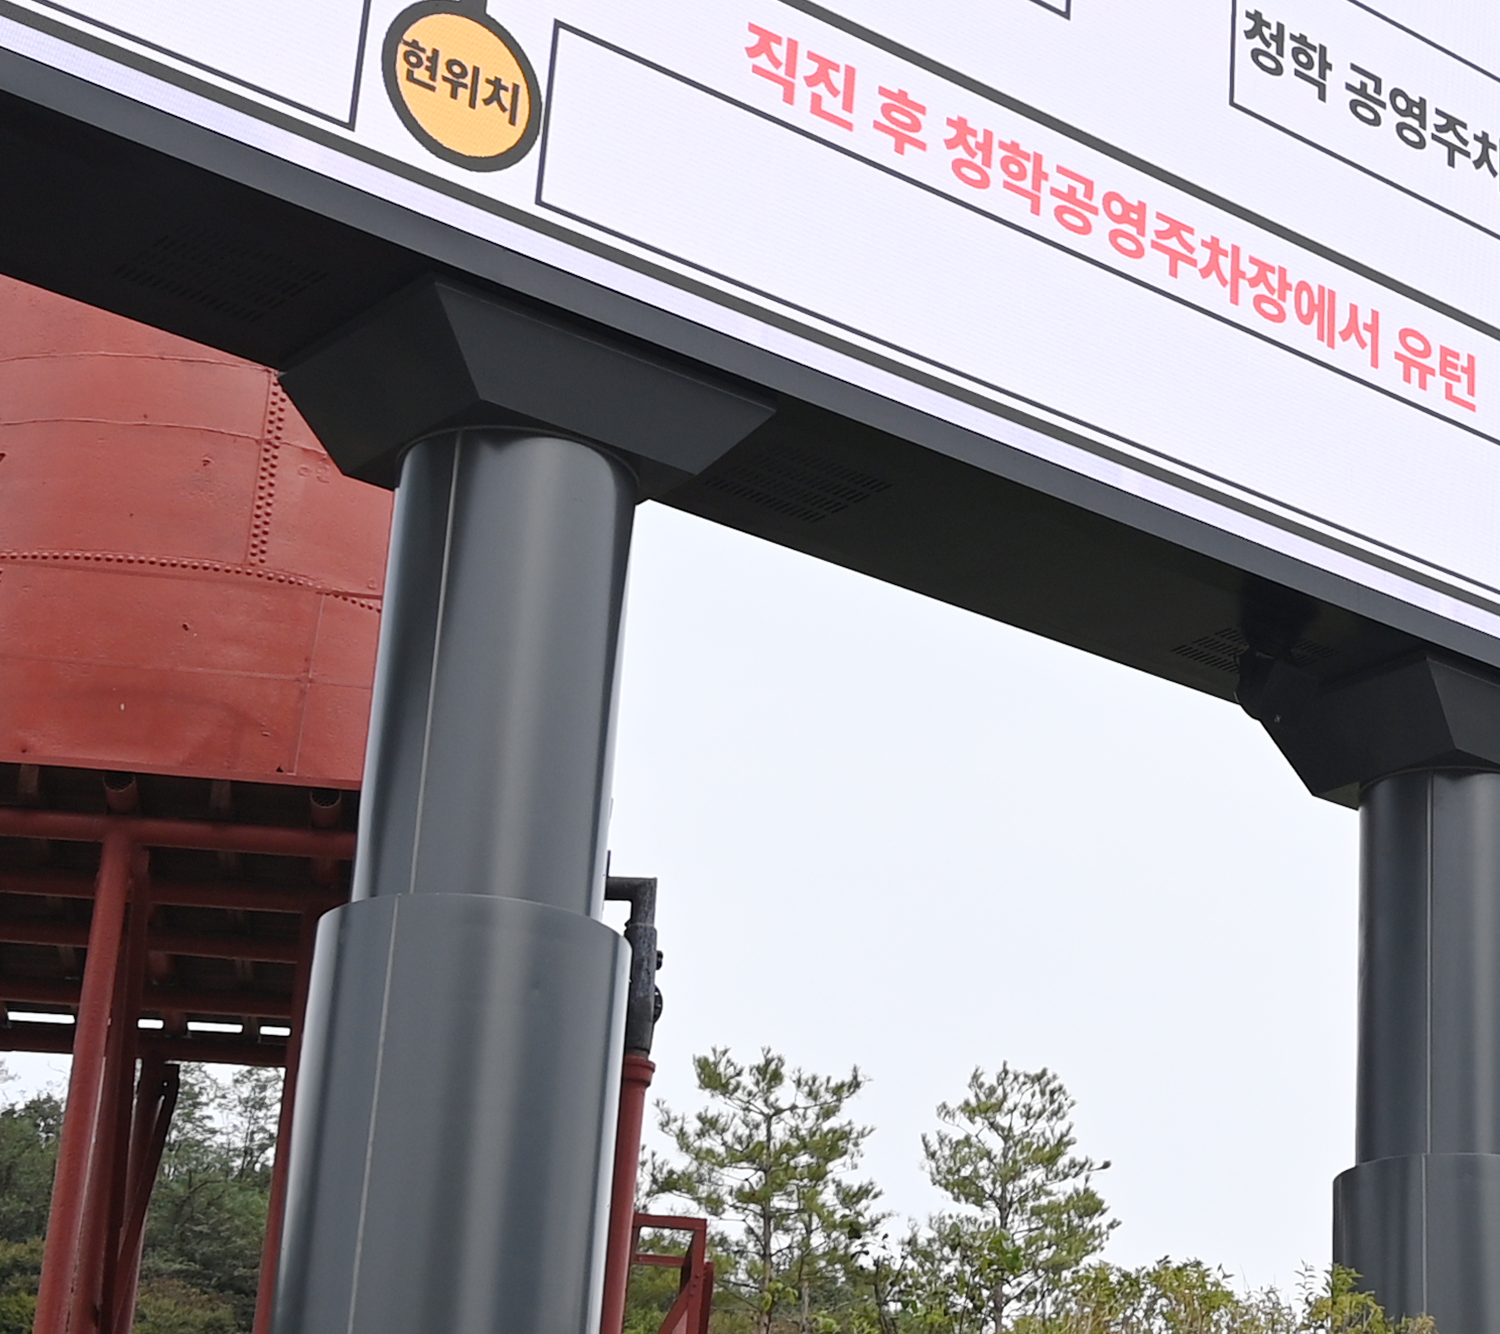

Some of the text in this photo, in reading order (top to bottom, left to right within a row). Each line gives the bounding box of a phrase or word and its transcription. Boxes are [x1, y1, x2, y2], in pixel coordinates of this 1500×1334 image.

[401, 37, 520, 127] 현위치
[1244, 9, 1332, 103] 청학
[744, 22, 1479, 413] 직진 후 청학공영주차장에서 유턴
